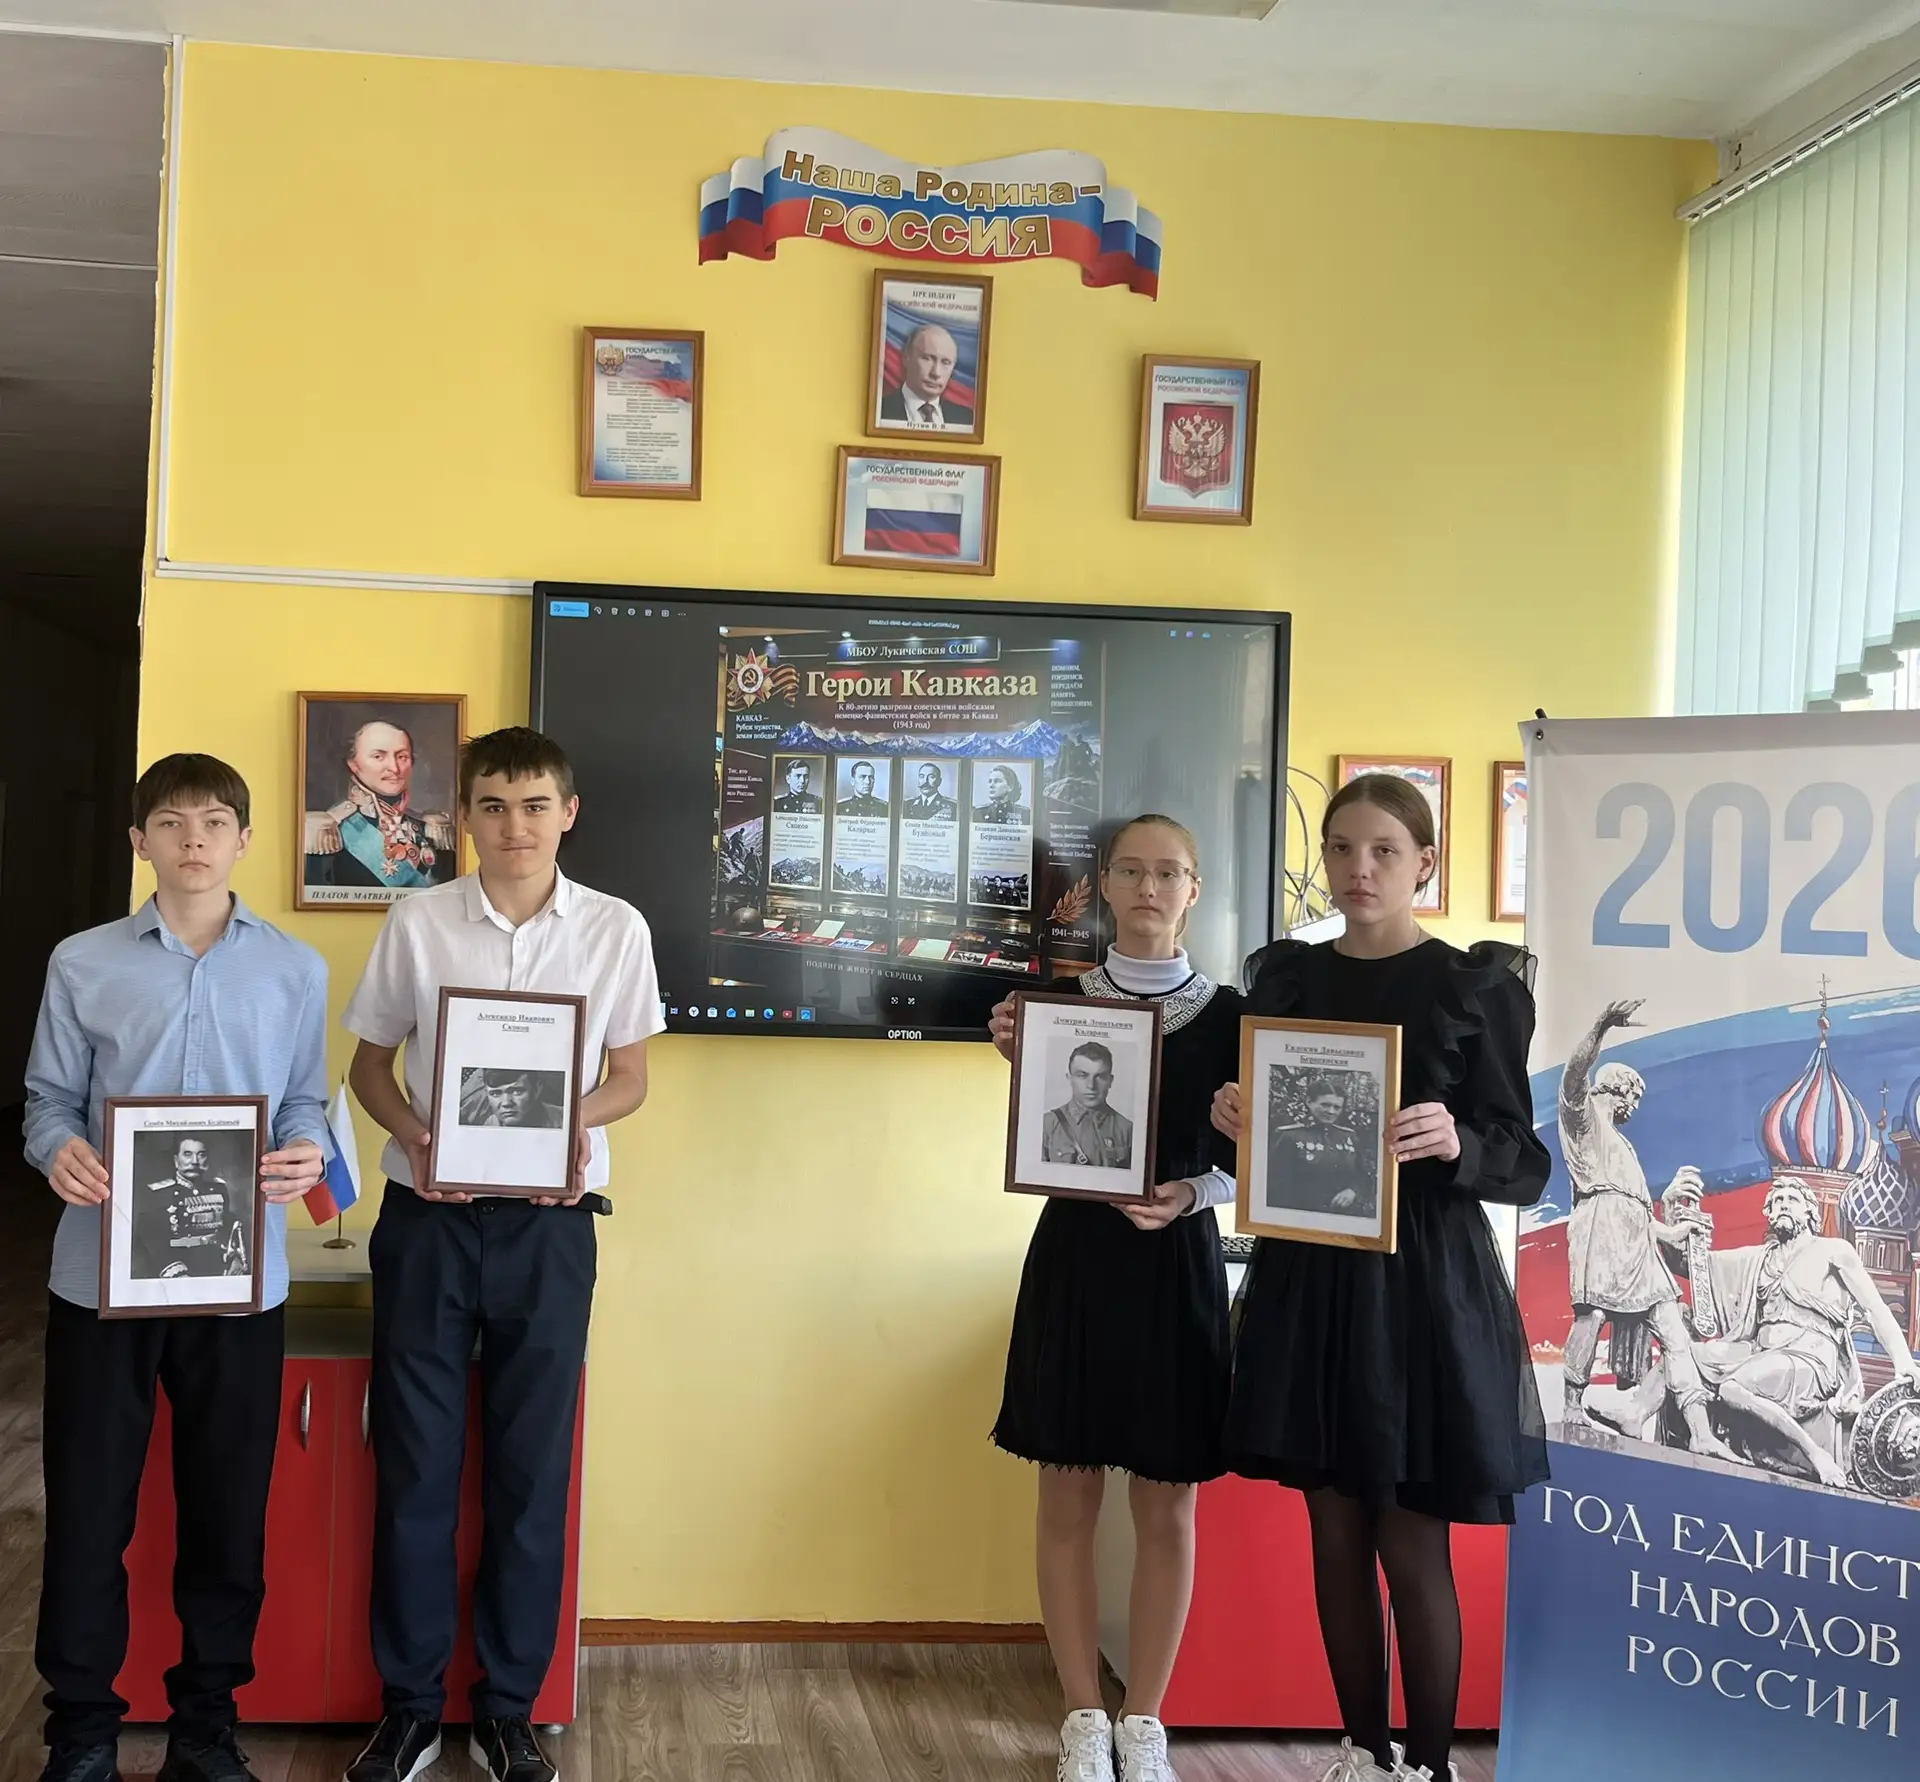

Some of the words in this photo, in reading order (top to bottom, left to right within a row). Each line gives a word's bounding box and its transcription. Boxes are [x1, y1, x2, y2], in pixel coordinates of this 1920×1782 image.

[780, 149, 902, 198] Наша
[804, 196, 1051, 257] РОССИЯ
[912, 290, 956, 300] ПРЕЗИДЕНТ
[1155, 374, 1227, 386] ГОСУДАРСТВЕННЫЙ
[906, 421, 930, 430] Путин
[866, 464, 944, 477] ГОСУДАРСТВЕННЫЙ
[945, 470, 966, 479] ФЛАГ
[872, 475, 917, 485] РОССИЙСКОЙ
[918, 477, 959, 487] ФЕДЕРАЦИИ
[846, 647, 878, 657] МБОУ
[880, 645, 945, 659] Лукичевская
[948, 643, 977, 655] СОШ
[806, 671, 892, 703] Герои
[900, 669, 1038, 697] Кавказа
[893, 719, 913, 729] (1943
[915, 720, 931, 730] год)
[312, 891, 349, 900] ПЛАТОВ
[353, 891, 391, 900] МАТВЕЙ
[806, 960, 844, 971] ПОДВИГИ
[846, 966, 874, 976] ЖИВУТ
[885, 970, 923, 982] СЕРДЦАХ
[888, 1029, 922, 1040] OPTION
[1543, 1486, 1651, 1551] ГОД
[1629, 1570, 1901, 1667] НАРОДОВ
[1626, 1634, 1899, 1738] РОССИИ
